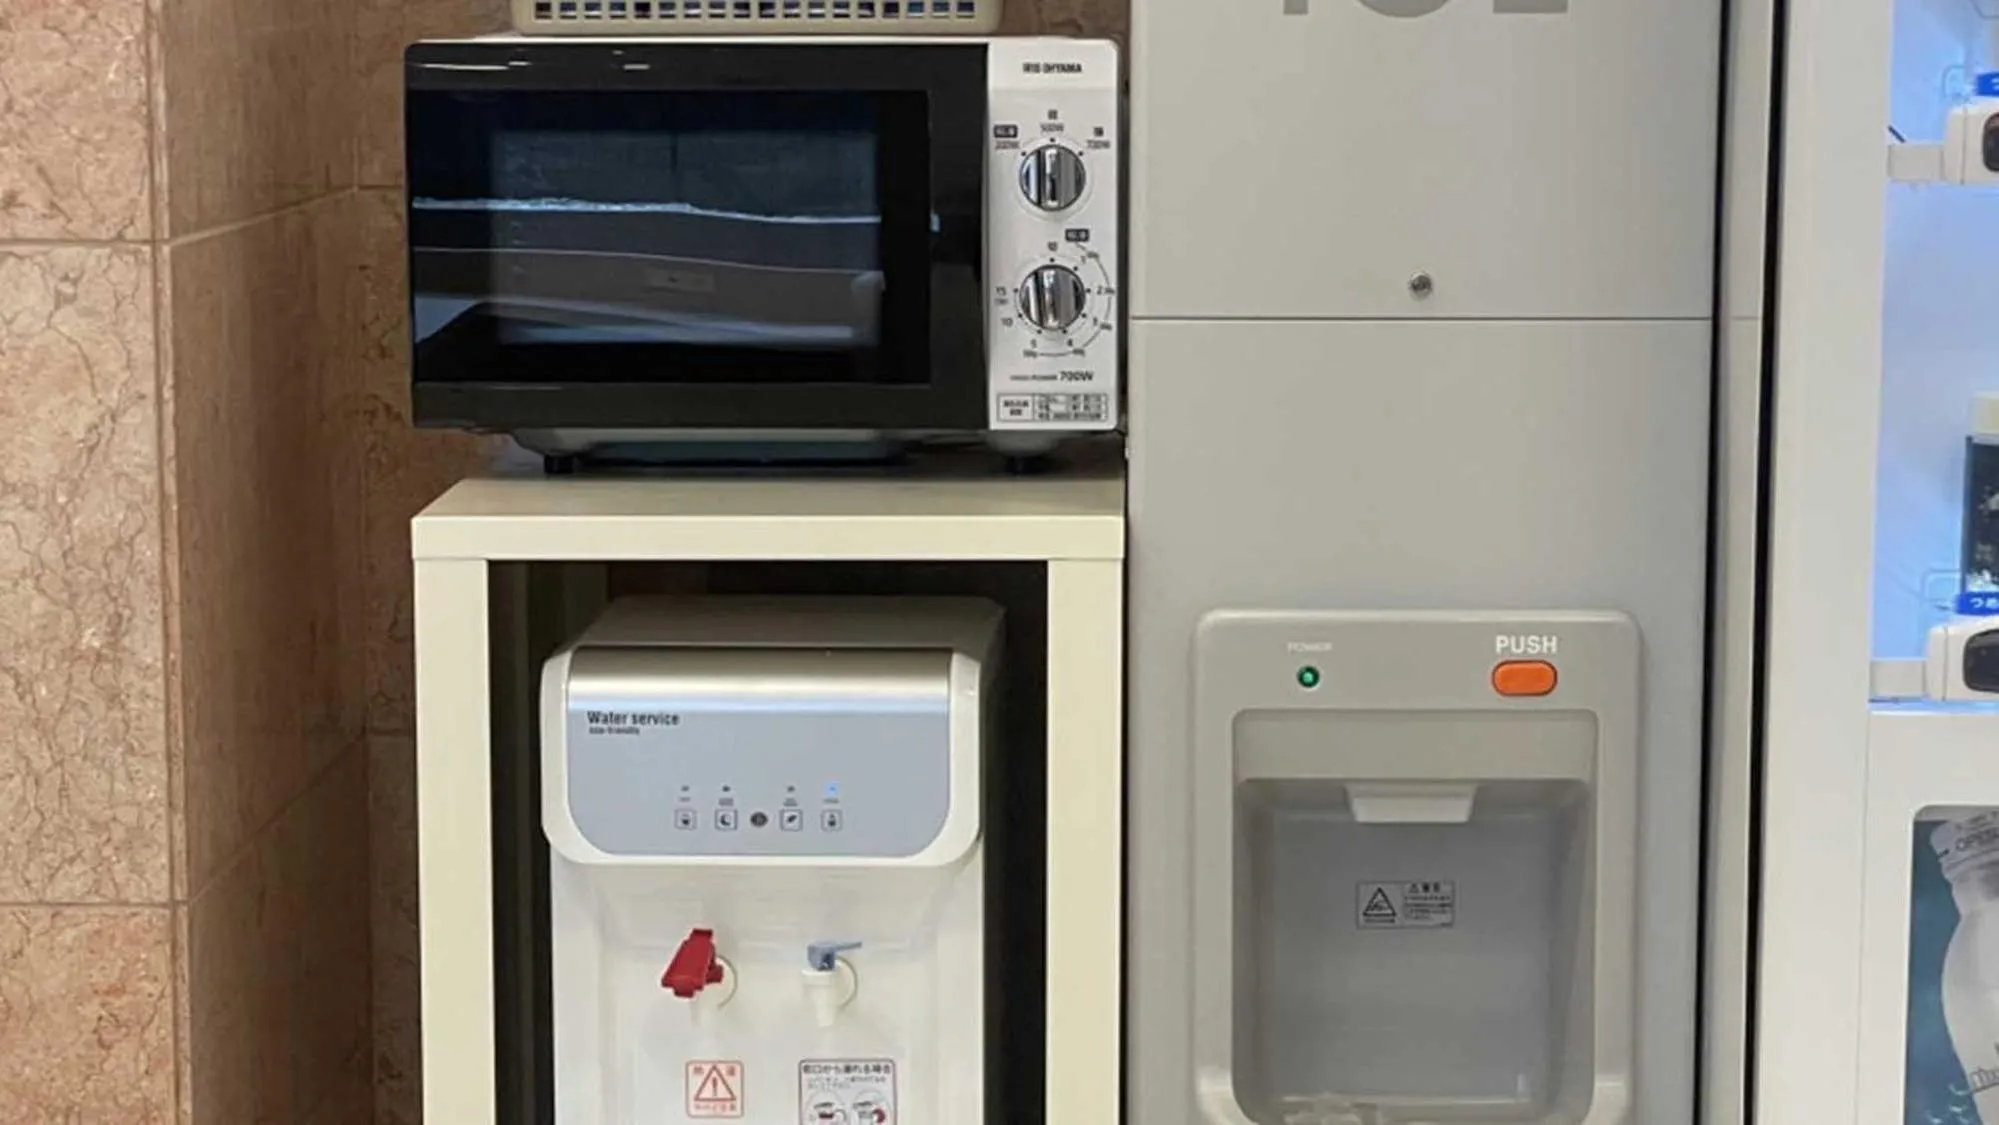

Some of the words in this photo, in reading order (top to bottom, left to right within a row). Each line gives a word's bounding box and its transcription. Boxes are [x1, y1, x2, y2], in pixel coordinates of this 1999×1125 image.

[1023, 63, 1041, 73] IRIS
[1043, 63, 1082, 73] OHYAMA
[1060, 371, 1093, 381] 700W
[1287, 642, 1333, 652] POWER
[1495, 635, 1557, 654] PUSH
[586, 711, 627, 725] Water
[631, 711, 679, 725] service
